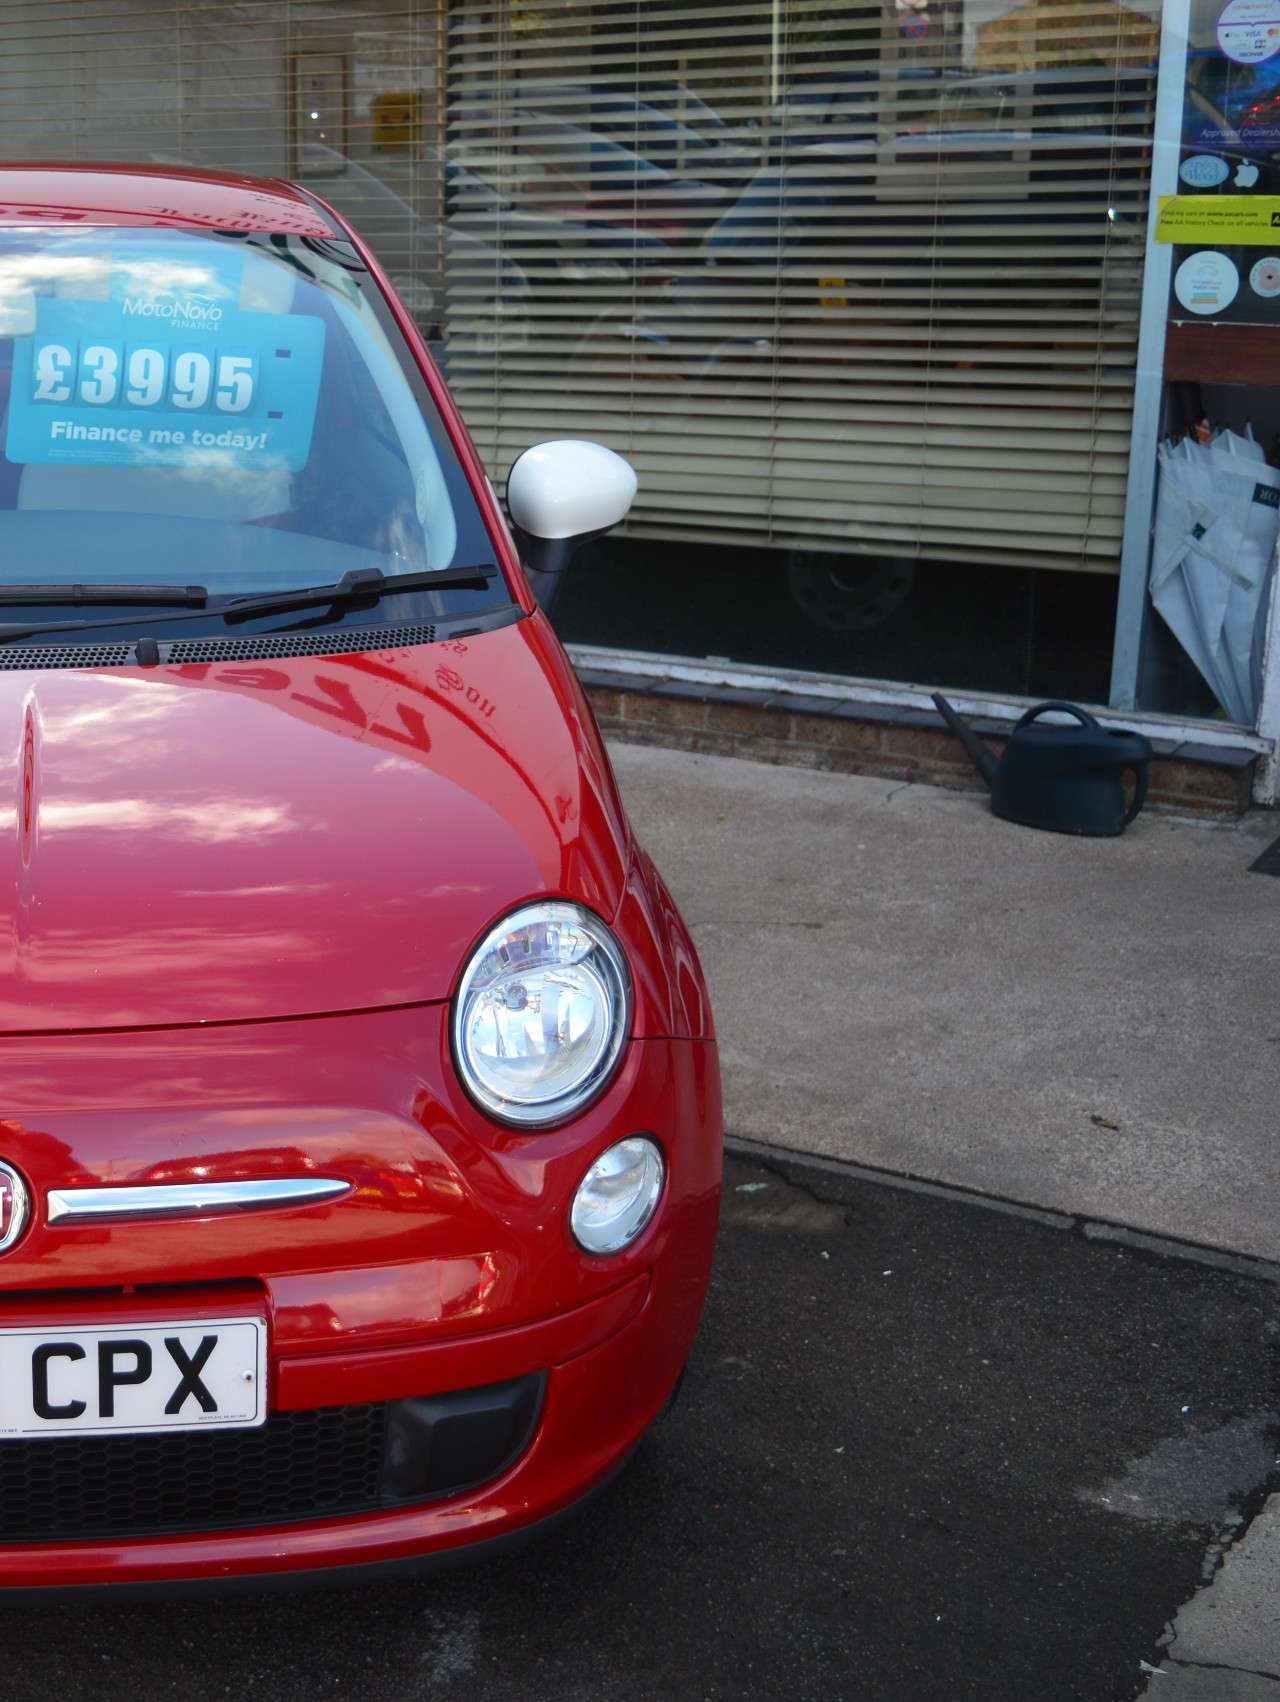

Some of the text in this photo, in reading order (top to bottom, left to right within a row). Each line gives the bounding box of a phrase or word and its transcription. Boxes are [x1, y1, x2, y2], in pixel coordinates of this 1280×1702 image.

[170, 319, 219, 331] FINANCE
[33, 344, 254, 412] £3995
[50, 421, 267, 450] Finance me today!
[31, 1335, 219, 1419] CPX
